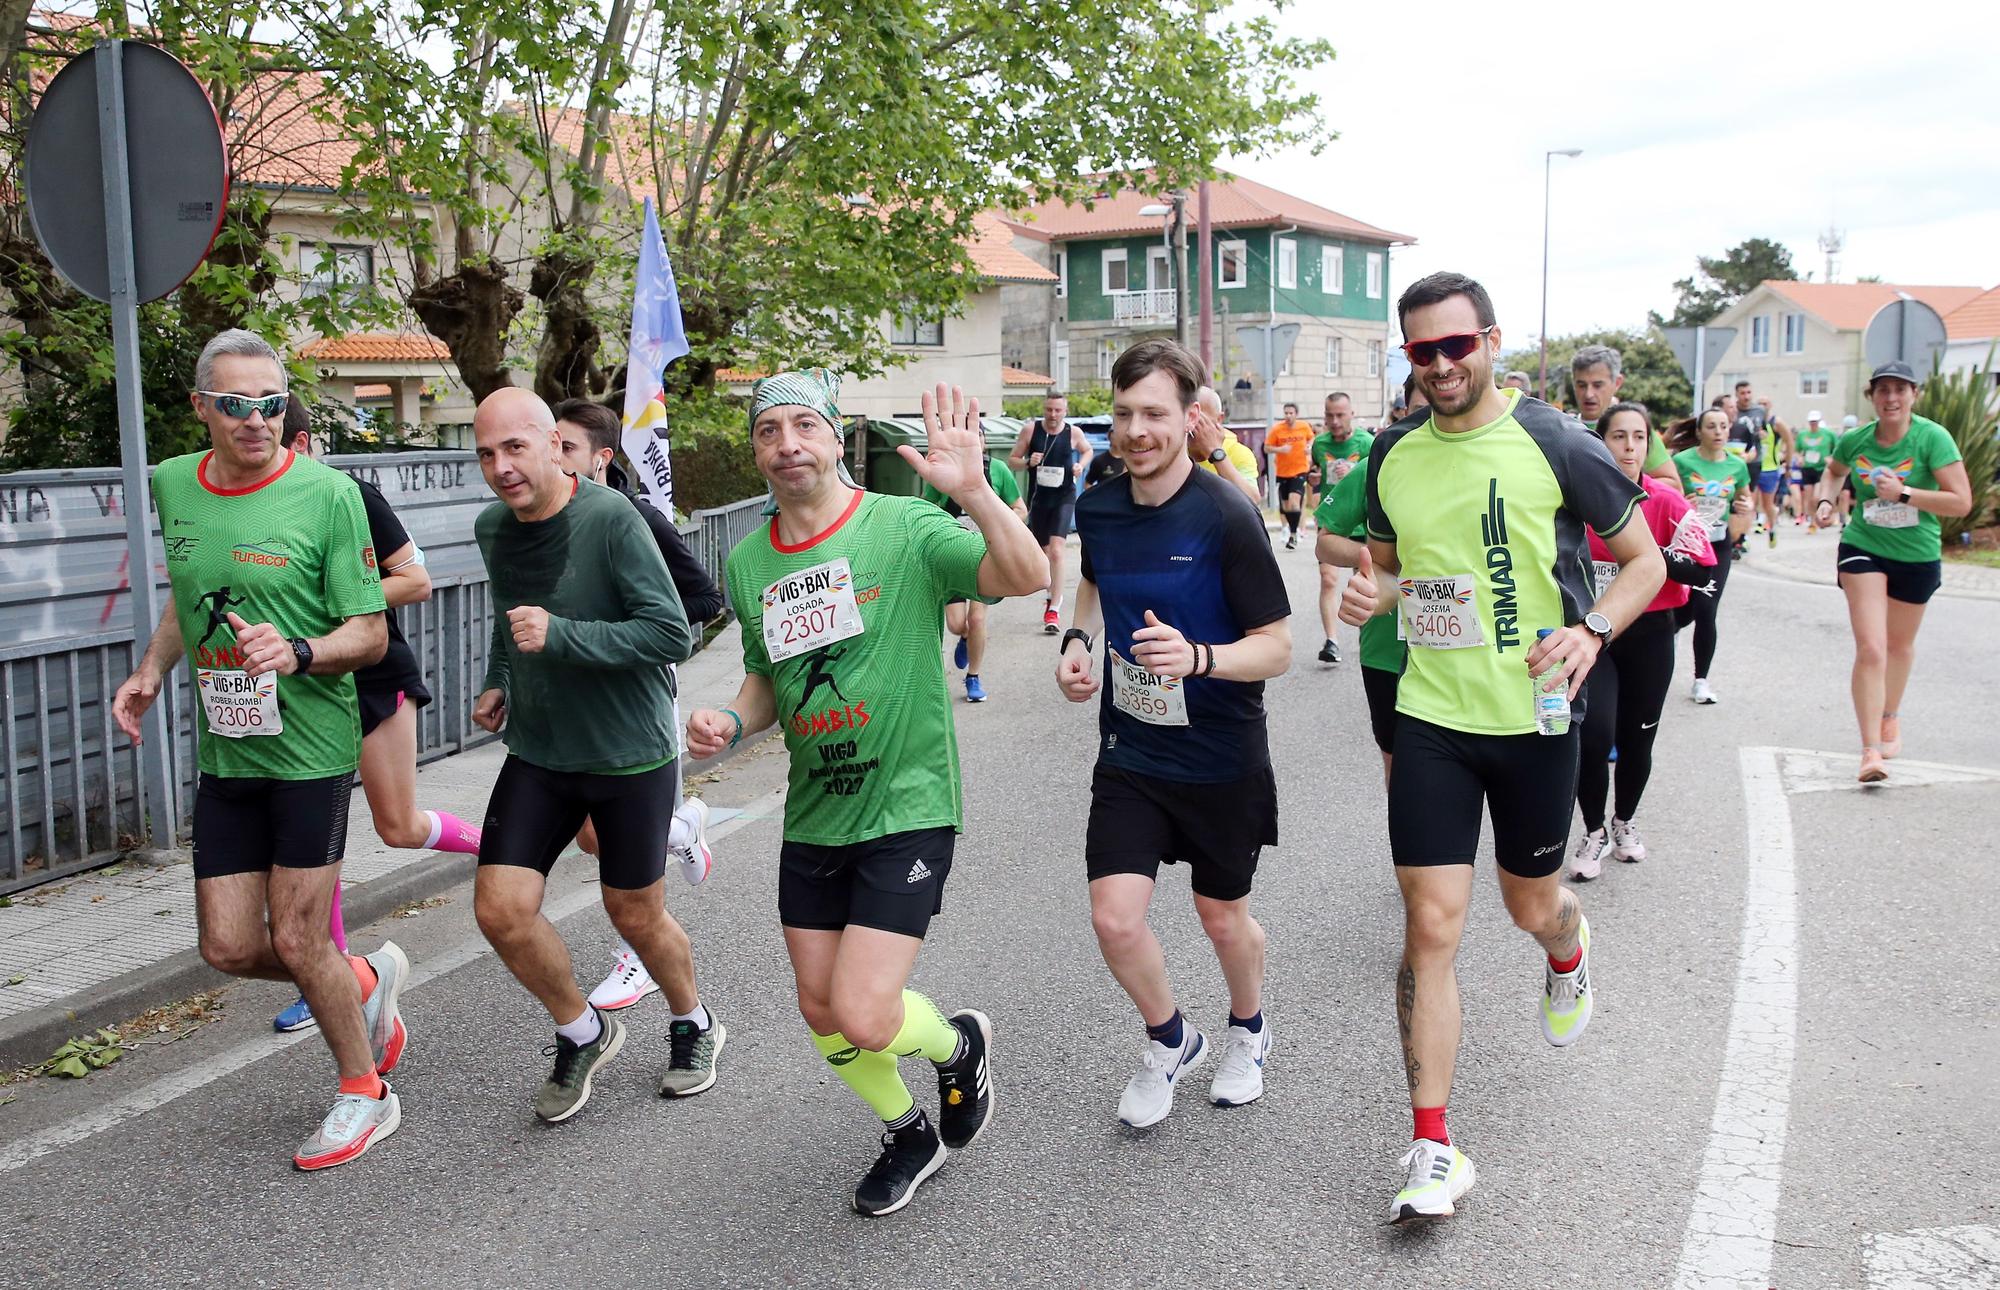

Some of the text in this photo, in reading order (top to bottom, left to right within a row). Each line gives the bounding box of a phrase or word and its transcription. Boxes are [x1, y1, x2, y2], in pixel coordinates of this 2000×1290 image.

[396, 461, 465, 491] VERDE
[786, 597, 825, 616] LOSADA
[1422, 605, 1451, 613] JOSEMA
[780, 604, 836, 644] 2307
[1416, 614, 1462, 637] 5406
[1128, 684, 1150, 696] HUGO
[1121, 687, 1168, 716] 5359
[214, 705, 263, 727] 2306
[818, 740, 857, 763] VIGO
[907, 869, 931, 883] adidas
